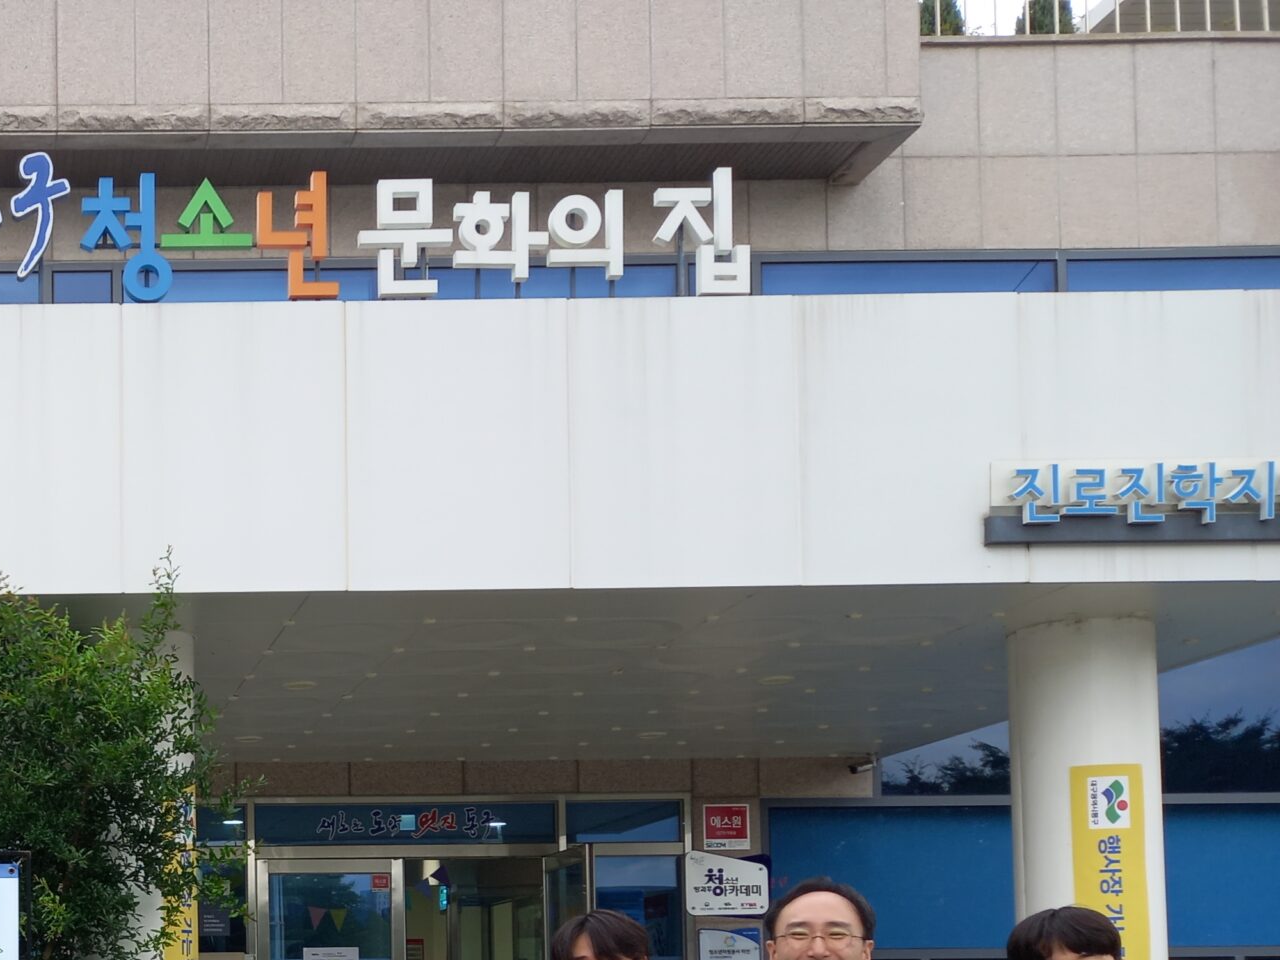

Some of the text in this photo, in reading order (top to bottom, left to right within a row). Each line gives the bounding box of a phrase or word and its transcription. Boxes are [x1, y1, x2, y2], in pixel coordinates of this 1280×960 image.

[80, 170, 340, 301] 청소년
[358, 177, 624, 299] 문화의
[652, 166, 751, 296] 집
[710, 815, 742, 828] 에스원
[1098, 835, 1124, 897] 행사장
[712, 885, 762, 897] 아카데미
